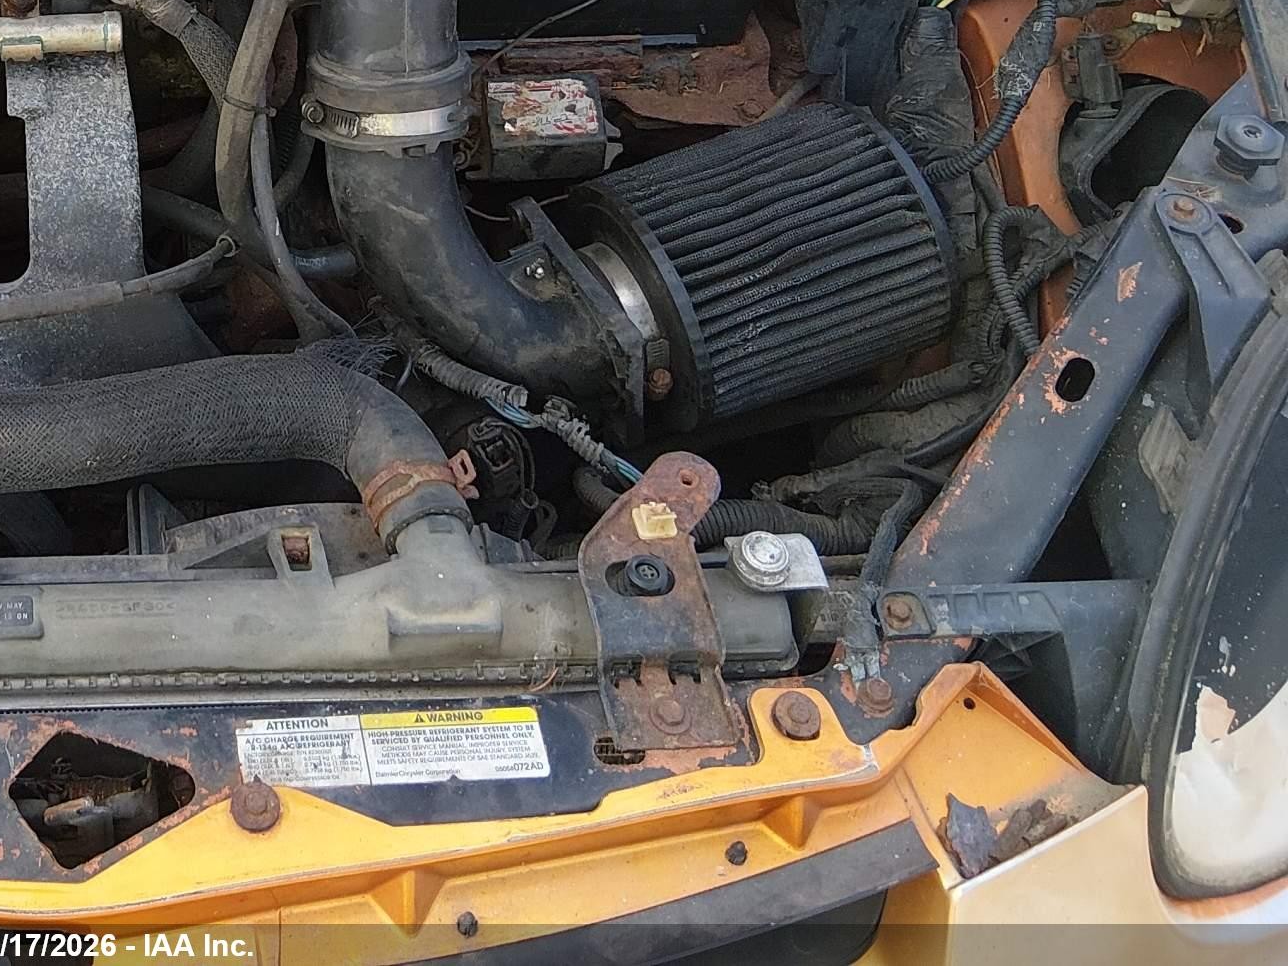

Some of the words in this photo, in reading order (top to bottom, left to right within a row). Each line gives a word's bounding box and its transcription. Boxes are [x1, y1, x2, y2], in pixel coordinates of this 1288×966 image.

[16, 612, 28, 620] ON
[427, 711, 484, 723] WARNING
[266, 718, 329, 731] ATTENTION
[428, 727, 481, 736] REFRIGERANT
[482, 725, 511, 734] SYSTEM
[264, 736, 298, 744] CHARGE
[300, 733, 355, 743] REQUIREMENT
[371, 737, 409, 745] SERVICED
[411, 736, 421, 744] BY
[423, 734, 463, 743] QUALIFIED
[464, 732, 510, 741] PERSONNEL
[512, 731, 535, 740] ONLY.
